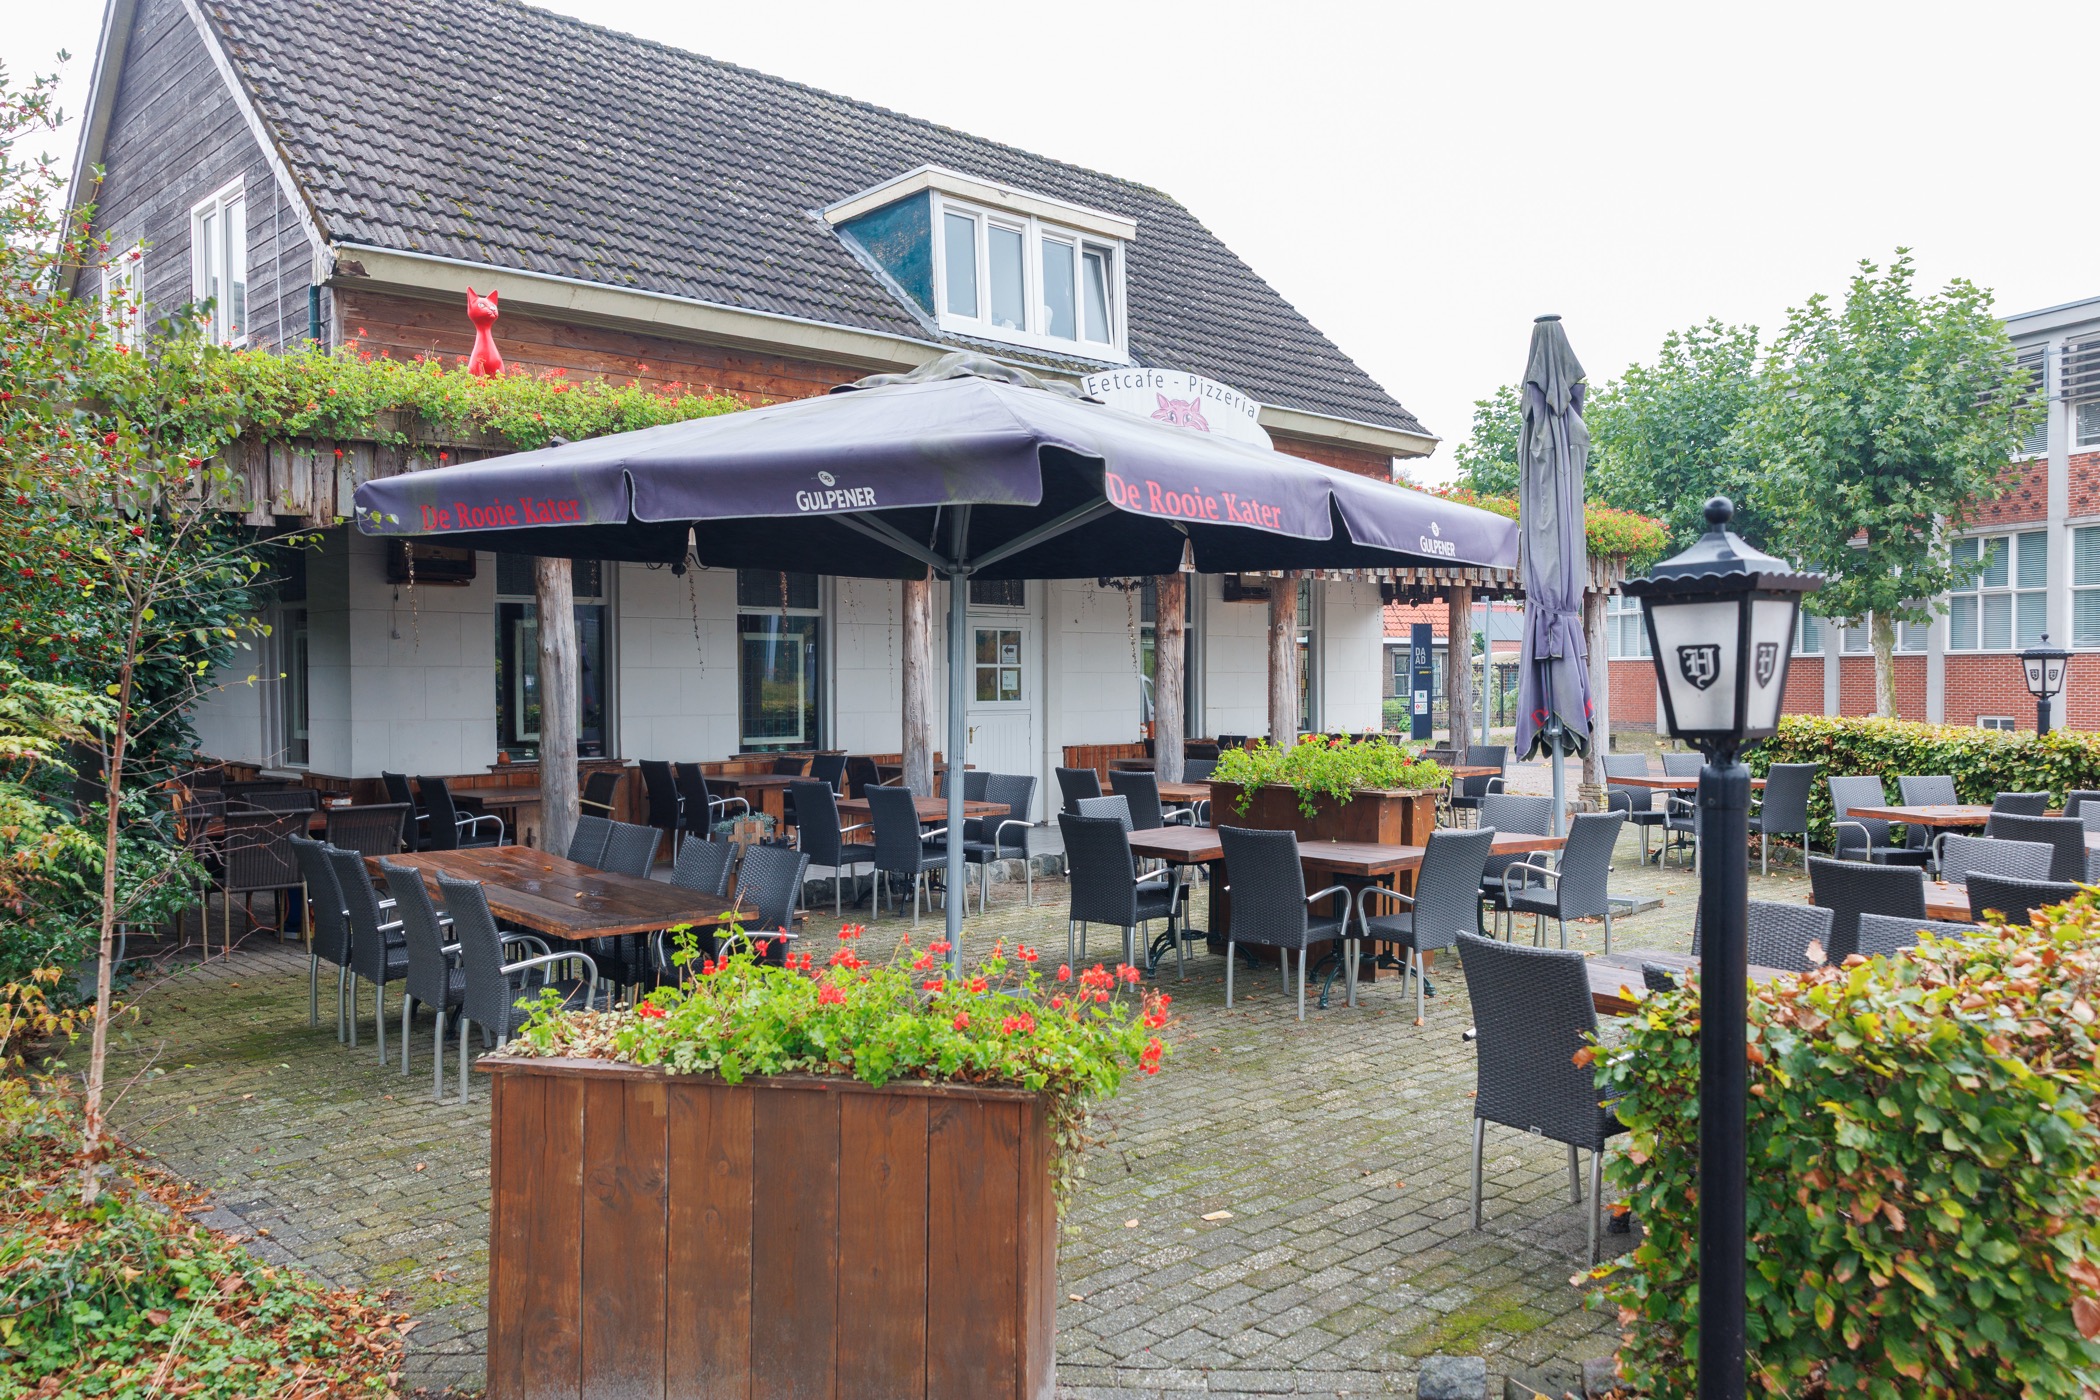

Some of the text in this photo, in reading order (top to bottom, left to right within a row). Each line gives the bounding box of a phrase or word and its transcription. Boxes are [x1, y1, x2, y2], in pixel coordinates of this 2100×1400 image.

[1087, 369, 1164, 396] Eetcafe
[1189, 375, 1255, 418] Pizzeria
[796, 487, 877, 511] GULPENER
[1106, 472, 1281, 529] De Rooie Kater
[420, 497, 581, 531] De Rooie Kater
[1420, 535, 1456, 557] GULPENER
[1415, 647, 1426, 656] DA
[1415, 655, 1426, 665] AD
